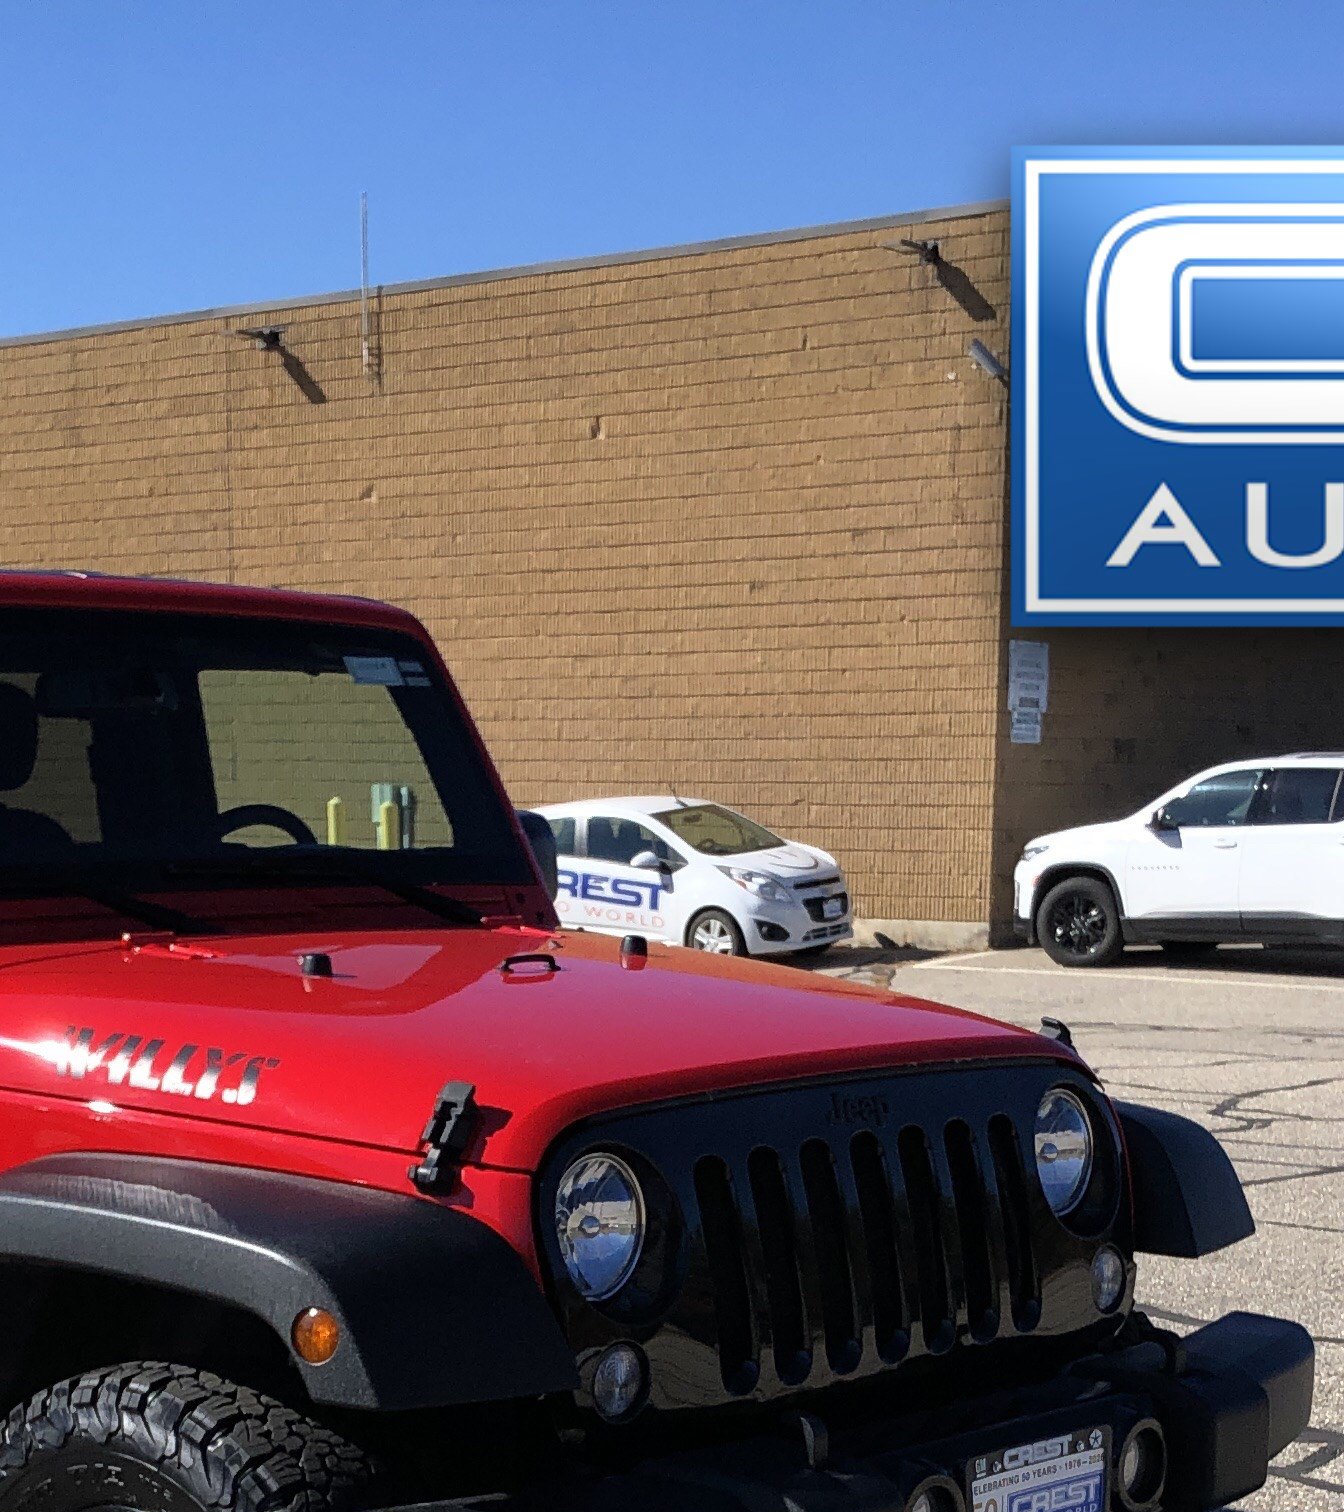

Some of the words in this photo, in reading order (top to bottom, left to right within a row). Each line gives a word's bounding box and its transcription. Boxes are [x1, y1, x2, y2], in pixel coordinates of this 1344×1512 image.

[556, 869, 664, 911] REST
[584, 905, 665, 928] WORLD
[56, 1025, 280, 1106] WILLYS
[1002, 1433, 1073, 1470] CREST
[973, 1474, 1019, 1497] ELEBRATING
[1032, 1464, 1058, 1479] YEARS
